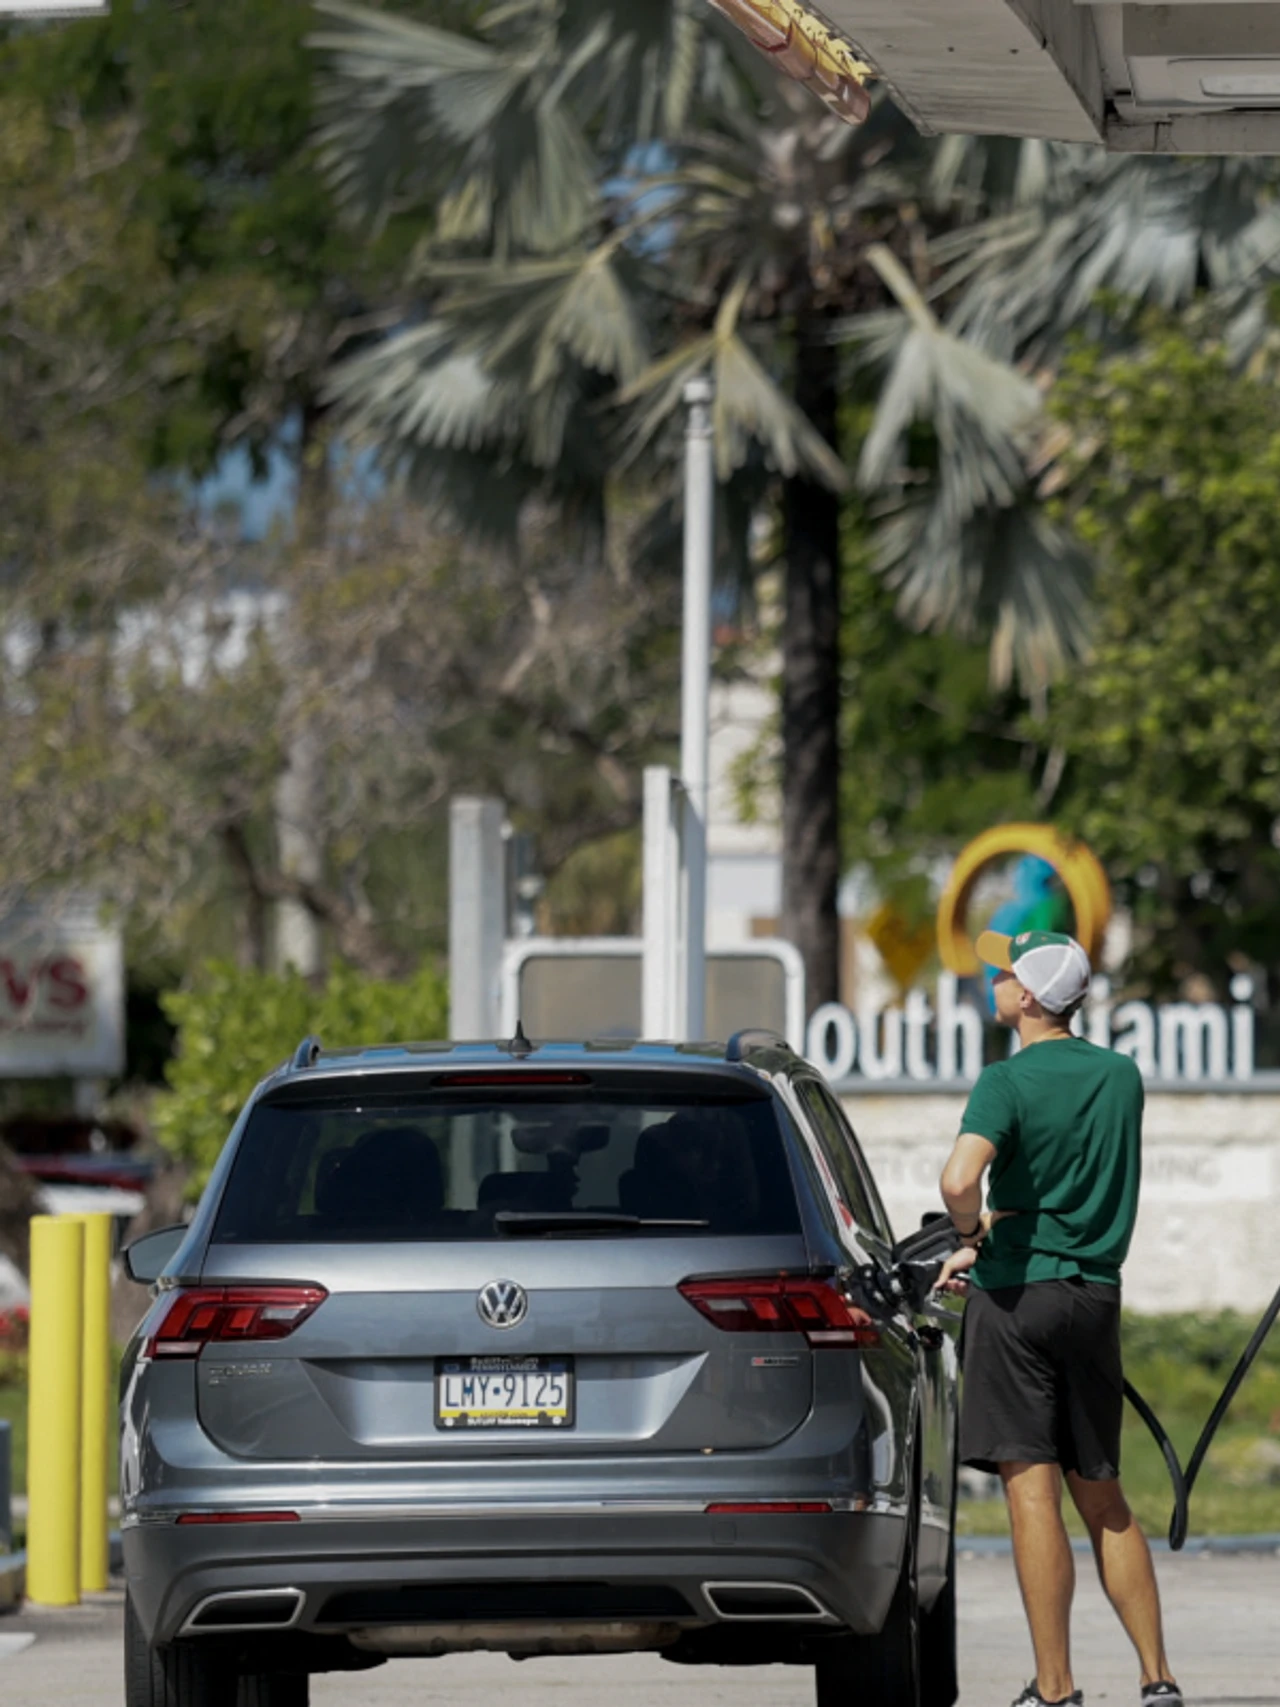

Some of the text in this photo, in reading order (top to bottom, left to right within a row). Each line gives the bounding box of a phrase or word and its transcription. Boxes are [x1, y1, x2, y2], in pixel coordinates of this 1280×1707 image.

[0, 957, 88, 1010] VS
[806, 973, 1255, 1082] outh iami
